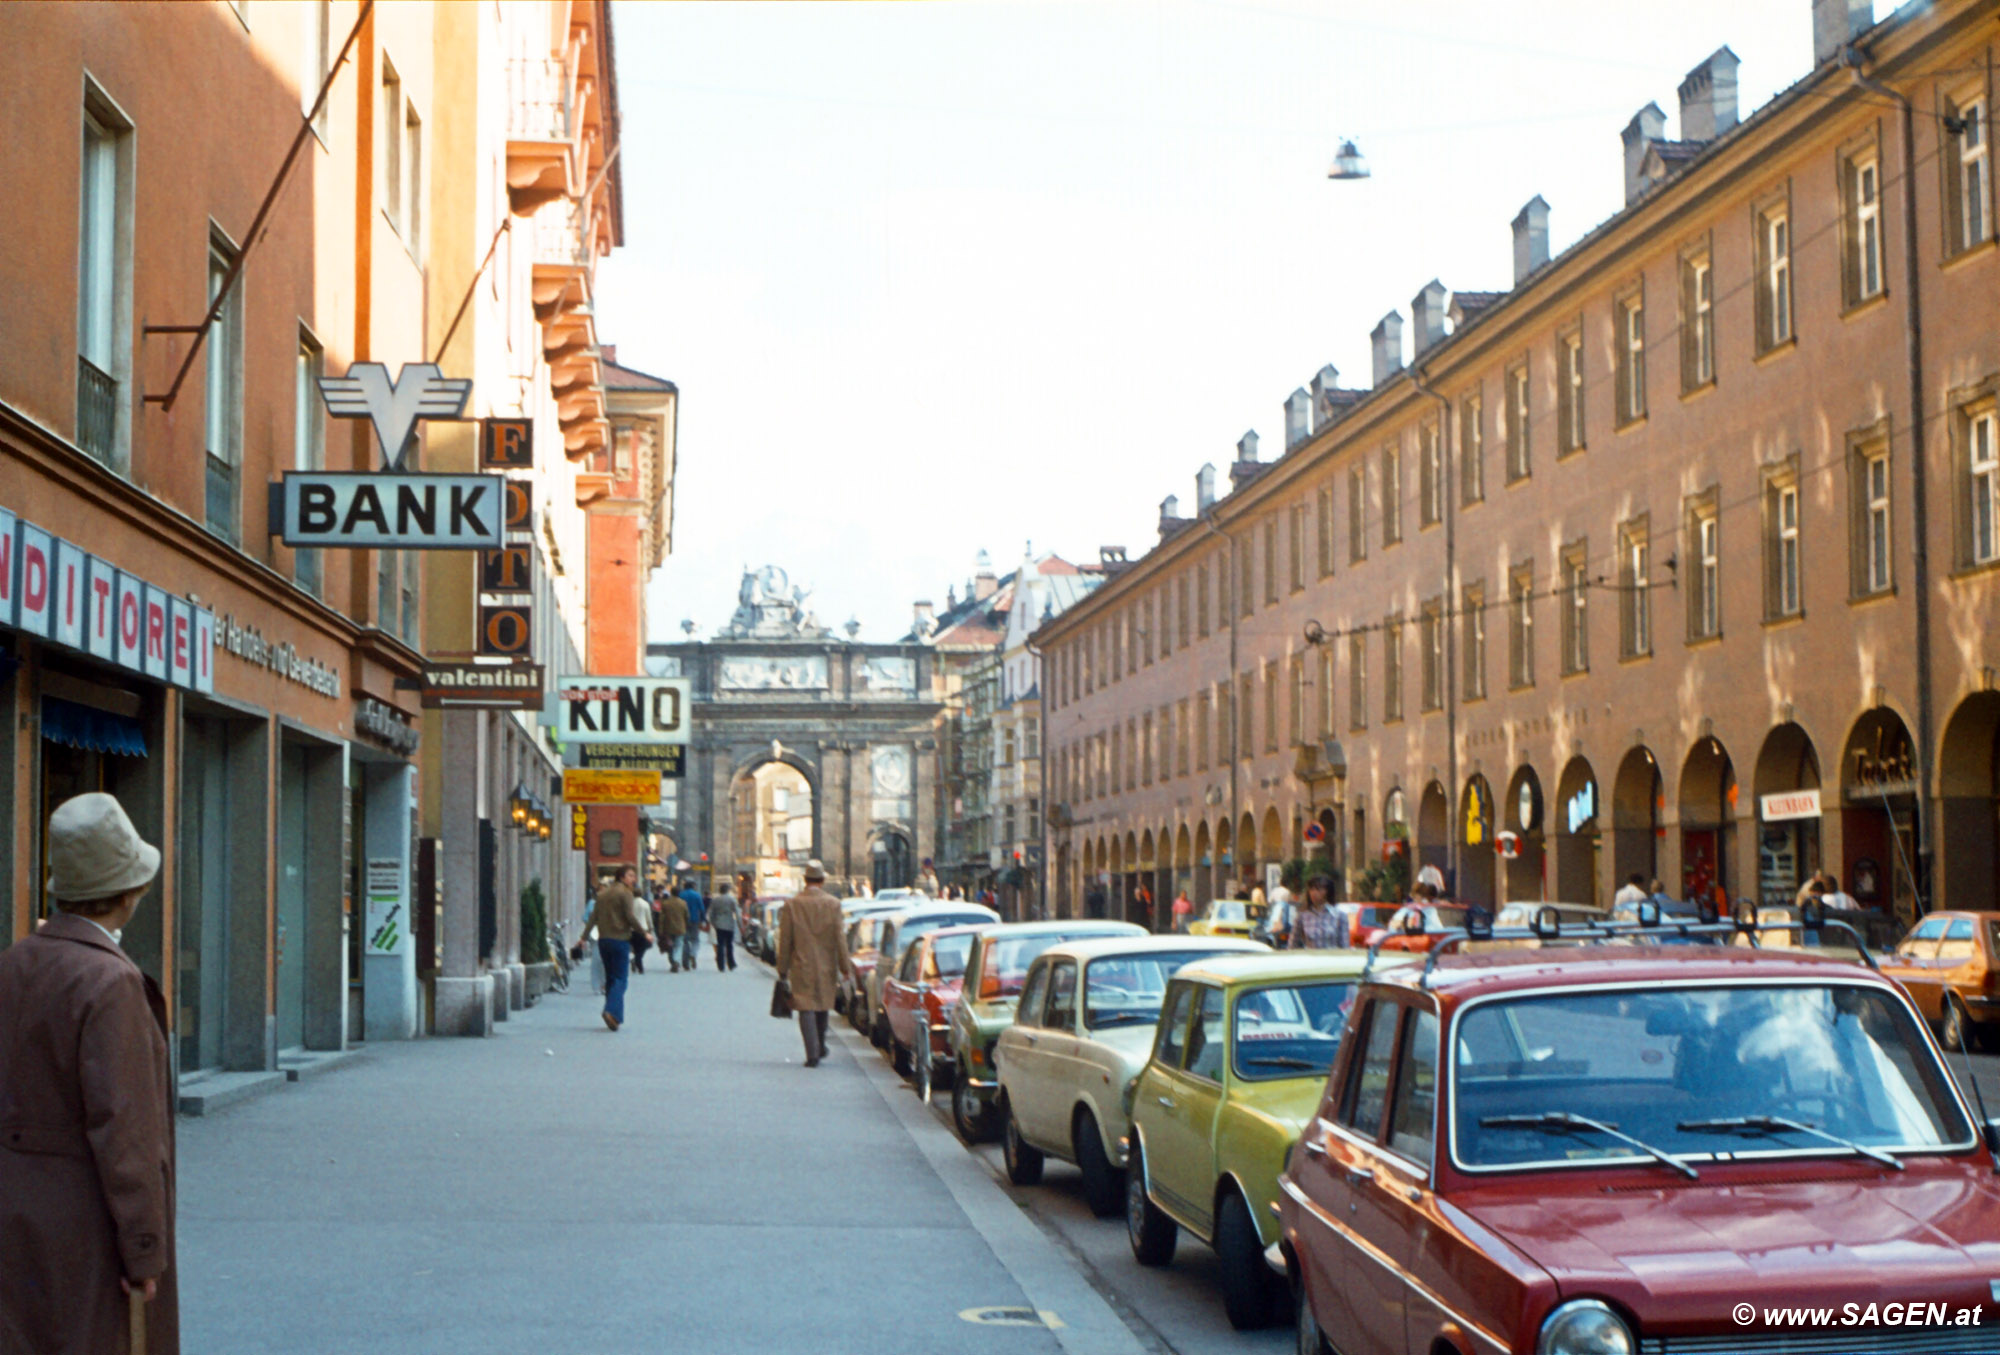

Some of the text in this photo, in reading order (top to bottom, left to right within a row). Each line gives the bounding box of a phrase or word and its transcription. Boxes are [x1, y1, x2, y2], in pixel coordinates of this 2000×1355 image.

[298, 483, 492, 536] BANK
[426, 669, 540, 688] valentini
[560, 690, 617, 700] NON STOP
[569, 686, 681, 732] KINO
[585, 744, 680, 757] VERSICHERUNGEN
